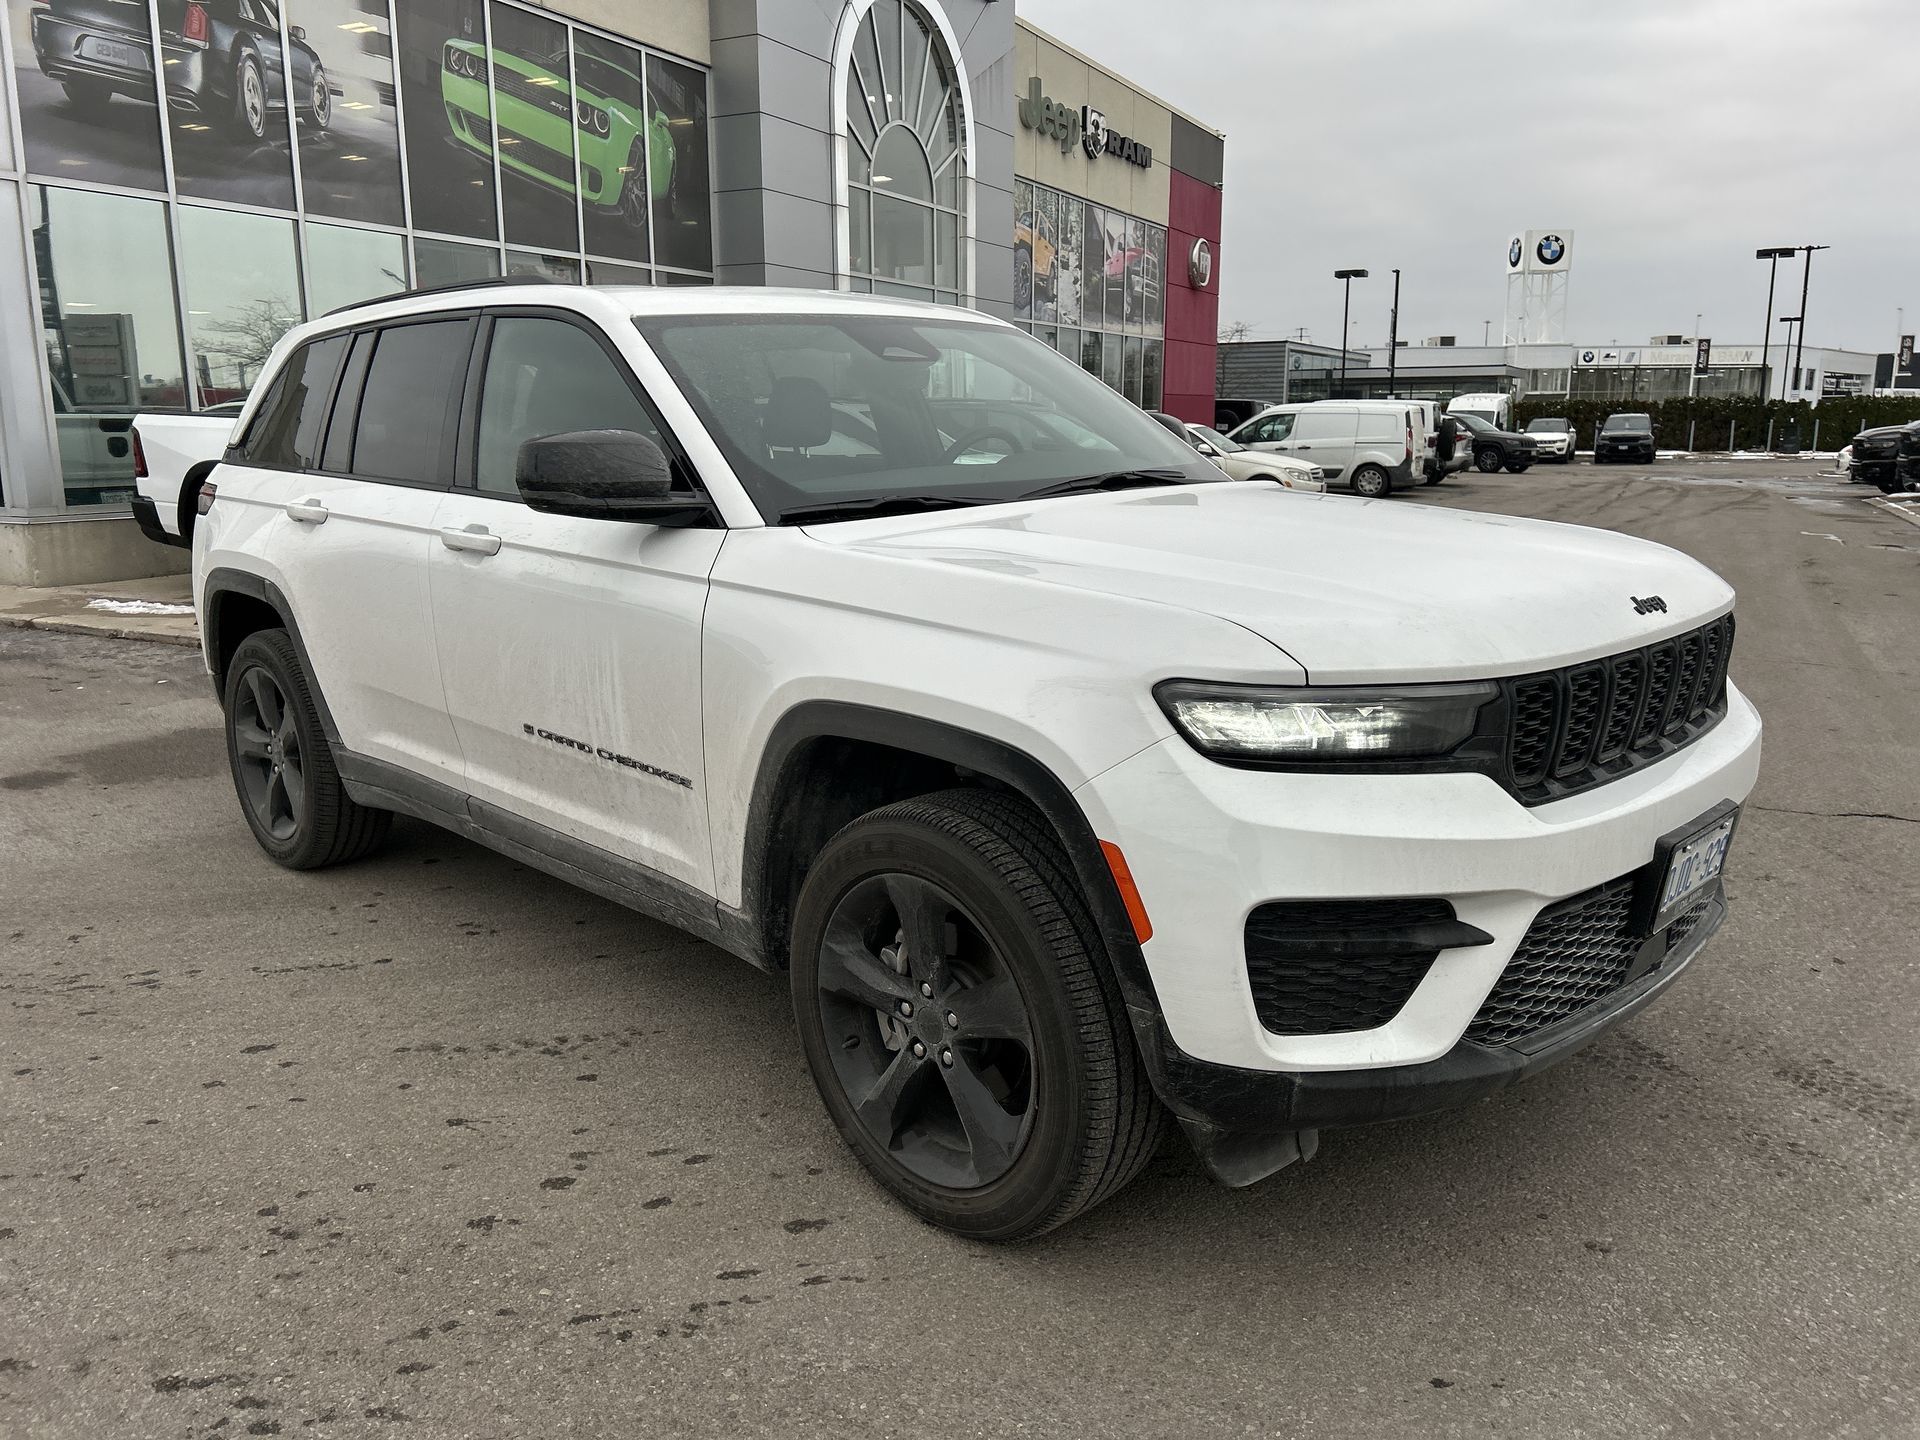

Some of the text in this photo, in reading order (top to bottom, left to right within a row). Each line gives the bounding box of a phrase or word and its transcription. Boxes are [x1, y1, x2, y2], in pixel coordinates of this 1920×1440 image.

[1019, 76, 1080, 153] Jeep
[1104, 128, 1152, 168] RAM
[1630, 595, 1667, 615] Jeep
